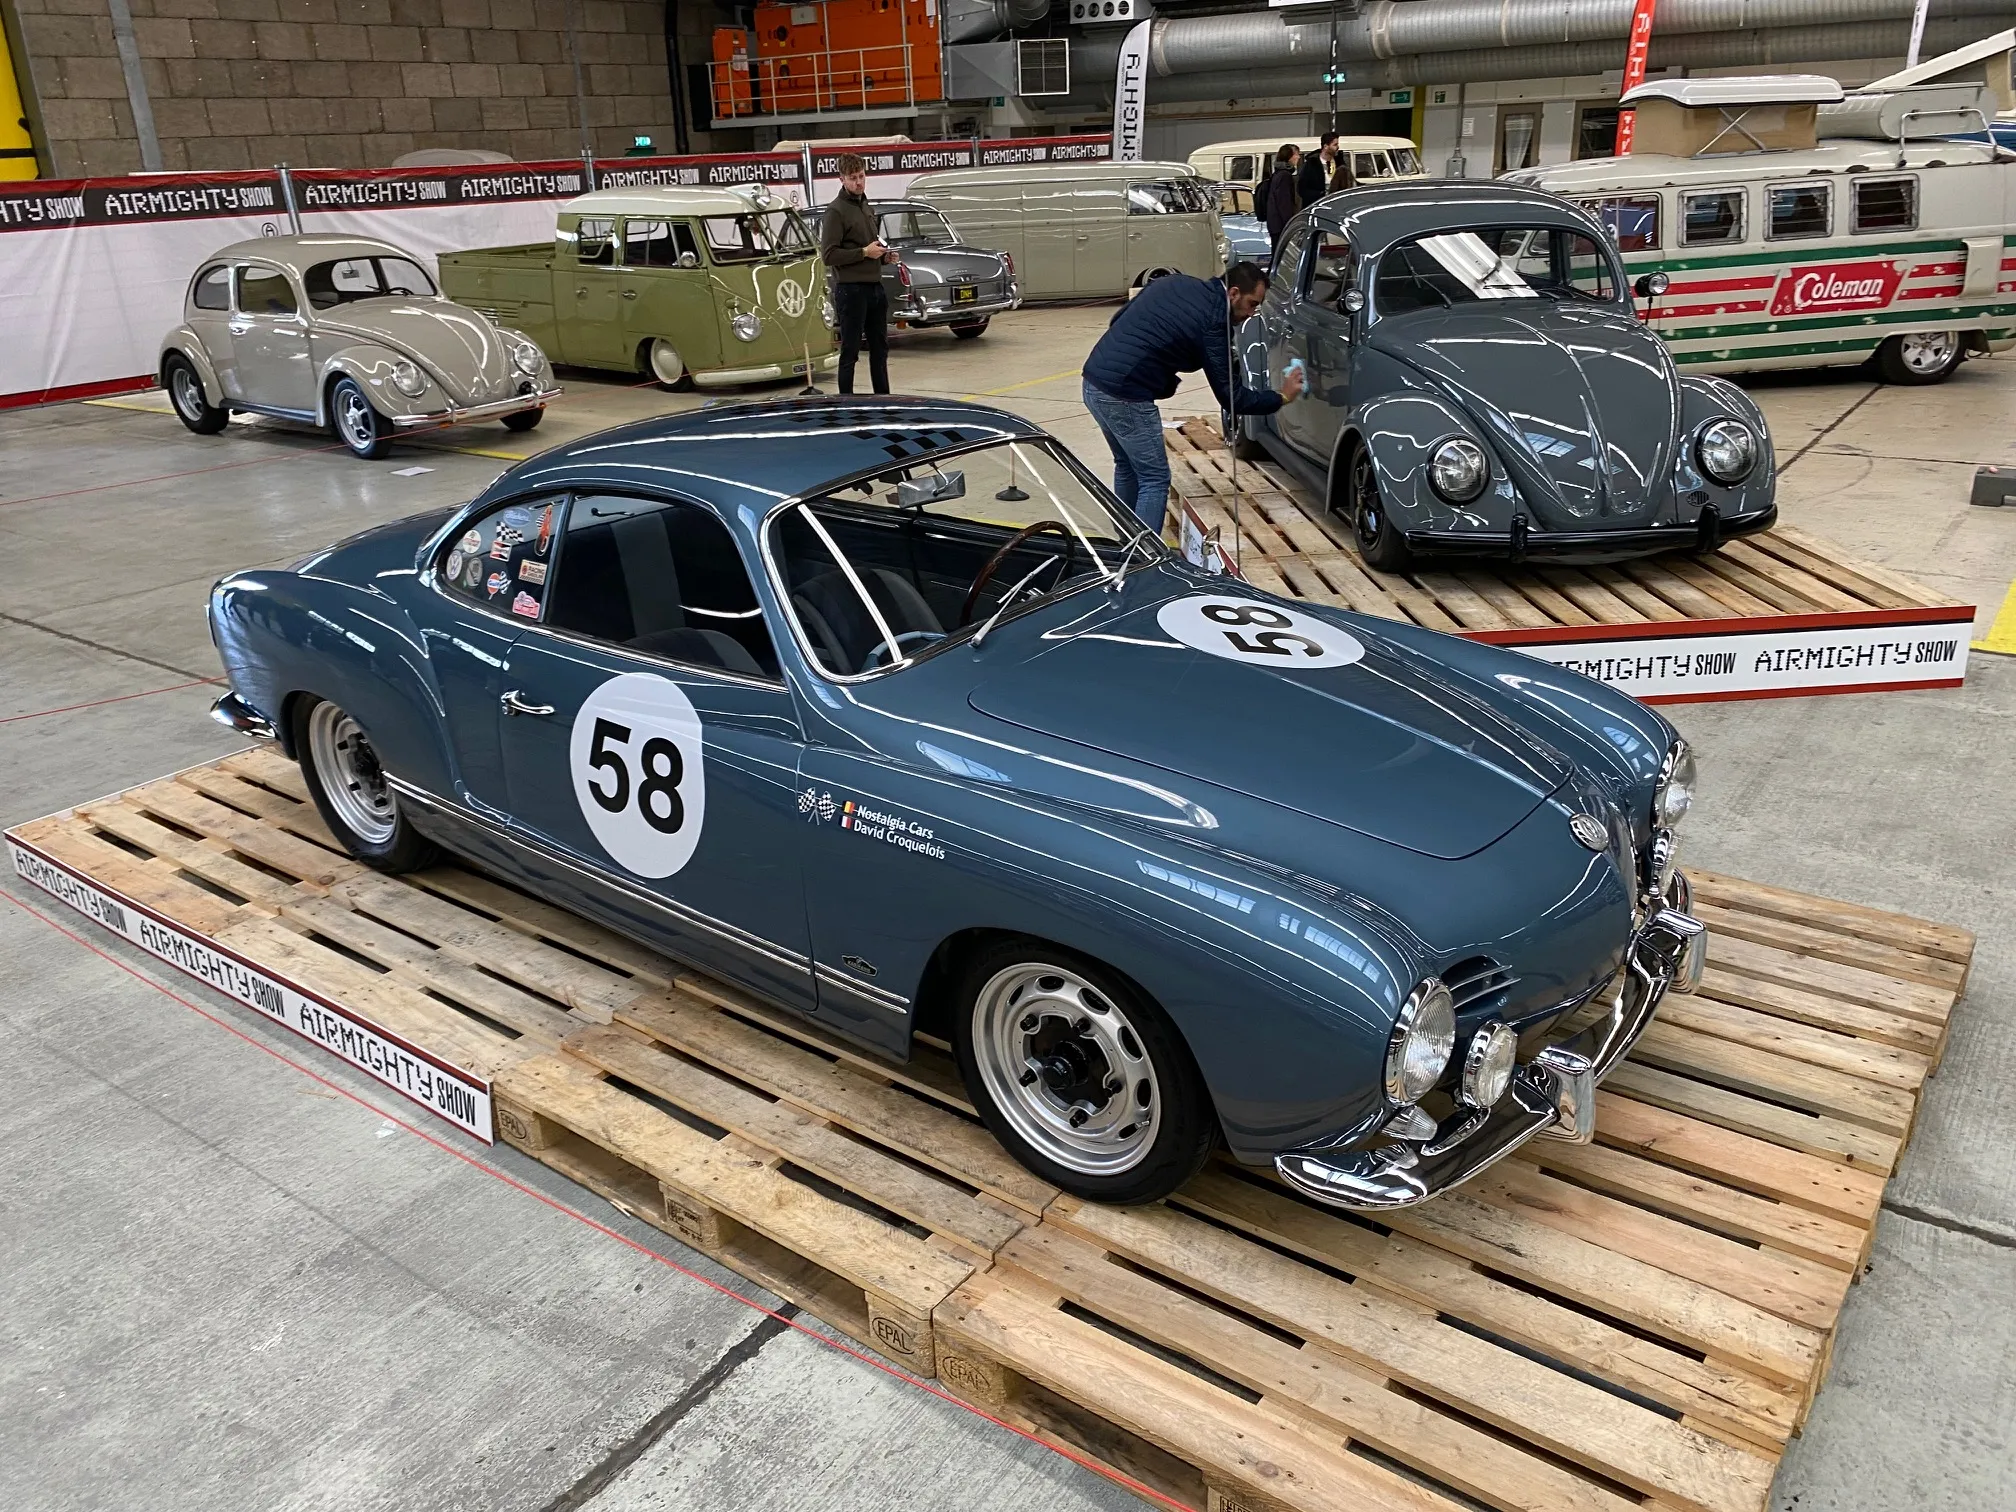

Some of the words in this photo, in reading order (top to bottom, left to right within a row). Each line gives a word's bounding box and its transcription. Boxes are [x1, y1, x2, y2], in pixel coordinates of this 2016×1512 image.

[901, 151, 955, 169] AIRMIGHTY
[983, 148, 1033, 164] AIRMIGHTY
[1051, 144, 1097, 160] AIRMIGHTY
[461, 175, 555, 198] AIRMIGHTY
[556, 174, 581, 193] SHOW
[602, 170, 679, 189] AIRMIGHTY
[709, 164, 780, 183] AIRMIGHTY
[46, 196, 85, 219] SHOW
[104, 187, 238, 216] AIRMIGHTY
[241, 186, 274, 208] SHOW
[305, 181, 418, 205] AIRMIGHTY
[419, 181, 446, 200] SHOW
[1794, 273, 1884, 308] Coleman
[1201, 605, 1324, 657] 58
[1695, 653, 1737, 676] SHOW
[1755, 642, 1913, 674] AIRMIGHTY
[1916, 640, 1958, 664] SHOW
[588, 717, 685, 834] 58
[857, 805, 906, 831] Nostalgia
[908, 822, 934, 839] Cars
[854, 820, 884, 839] David
[886, 831, 945, 860] Croquelois
[15, 849, 100, 918] AIRMIGHTY
[99, 898, 128, 933] SHOW
[140, 920, 250, 999] AIRMIGHTY
[252, 976, 286, 1018] SHOW
[299, 1003, 434, 1101] AIRMIGHTY
[436, 1076, 476, 1127] SHOW
[501, 1113, 522, 1134] EPAL
[877, 1320, 911, 1352] EPAL
[950, 1360, 981, 1391] EPAL
